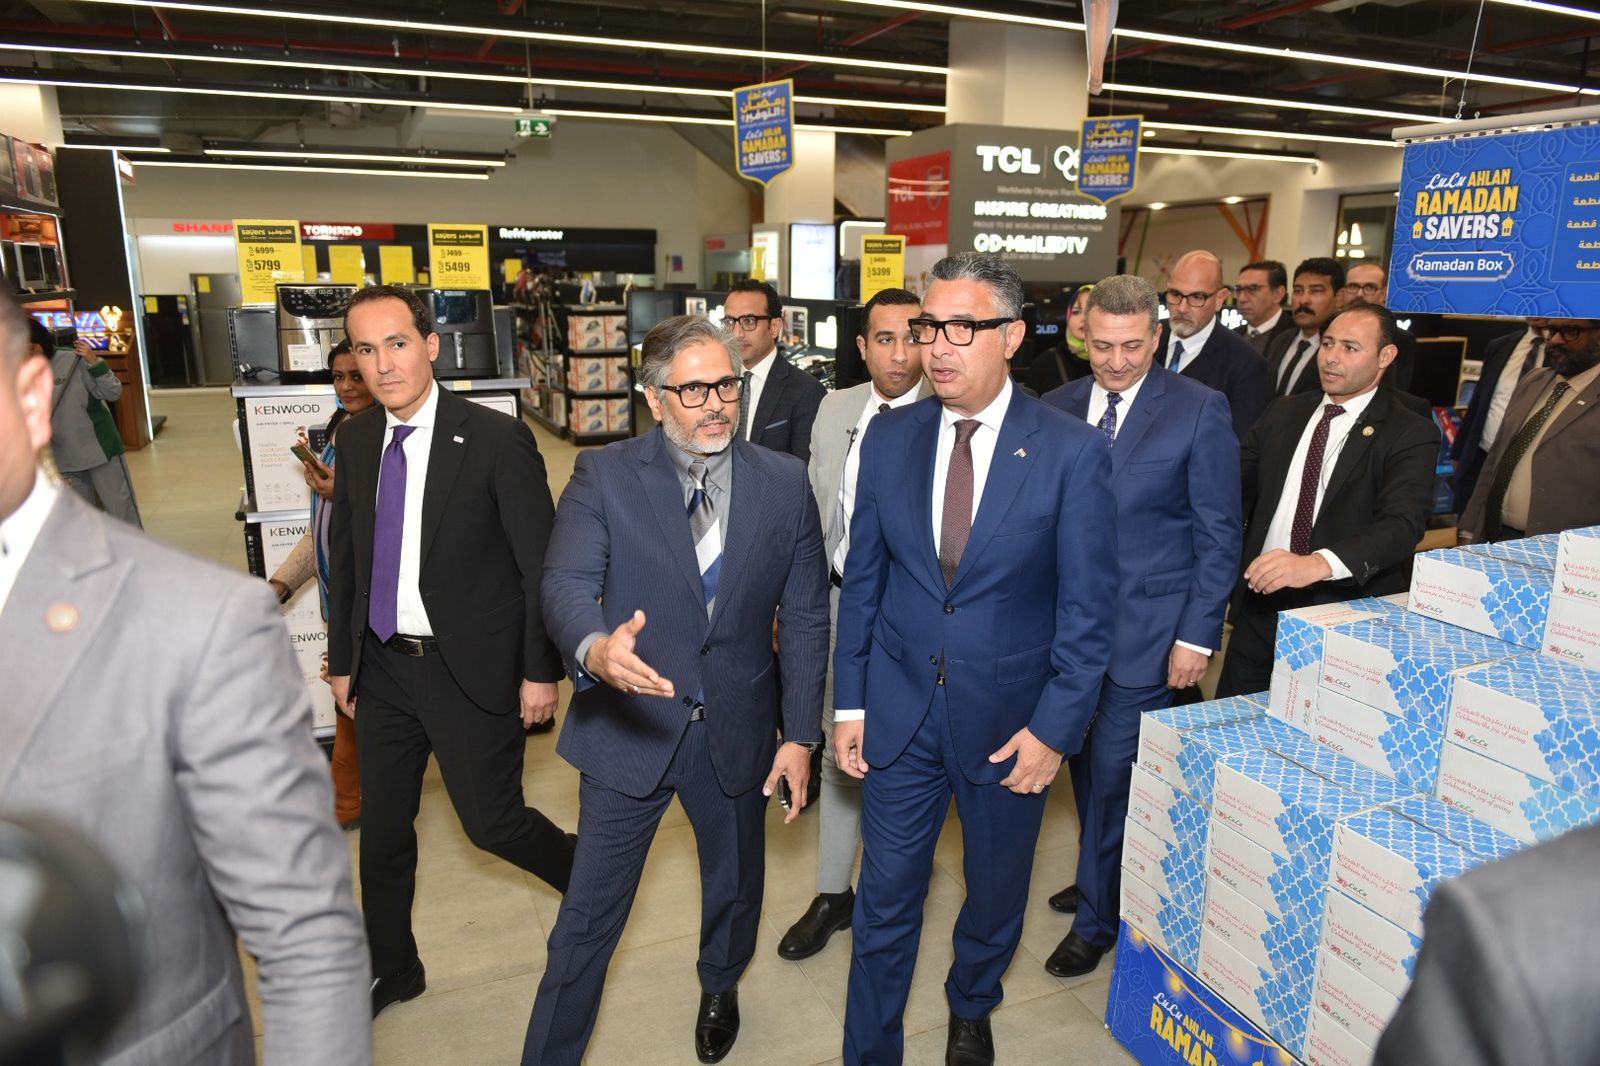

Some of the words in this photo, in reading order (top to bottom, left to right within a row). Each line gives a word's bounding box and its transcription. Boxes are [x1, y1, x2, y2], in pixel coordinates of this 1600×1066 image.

[742, 134, 787, 153] RAMADAN
[748, 150, 781, 166] SAVERS
[976, 145, 1041, 174] TCL
[1083, 162, 1130, 174] RAMADAN
[1088, 174, 1123, 186] SAVERS
[1425, 172, 1468, 190] LuLu
[1467, 168, 1511, 187] AHLAN
[894, 186, 915, 203] TCL
[1061, 188, 1077, 196] Part
[1415, 186, 1519, 216] RAMADAN
[1573, 196, 1600, 206] طعة
[974, 200, 1029, 217] INSPIRE
[1030, 202, 1107, 220] GREATNESS
[173, 222, 233, 233] SHARP
[303, 225, 363, 236] TORNADO
[1424, 214, 1500, 240] SAVERS
[1567, 220, 1597, 229] قطعة
[500, 227, 563, 241] Refrigerator
[254, 260, 281, 271] 5799
[445, 262, 471, 272] 5499
[1416, 259, 1474, 271] Ramadan
[1478, 258, 1503, 271] Box
[872, 267, 891, 276] 5399
[255, 404, 320, 415] KENWOOD
[270, 526, 307, 537] KENW
[1576, 588, 1597, 598] LuLu
[290, 632, 328, 643] ENWO
[1562, 648, 1584, 659] LuLu
[1335, 678, 1351, 688] LuLu
[1455, 711, 1479, 725] Celebrate
[1508, 735, 1526, 744] giving
[1467, 735, 1488, 746] LuLu
[1442, 778, 1466, 793] Celebrate
[1494, 804, 1511, 815] giving
[1453, 801, 1474, 813] LuLu
[1336, 859, 1360, 875] Celebrate
[1348, 882, 1368, 897] LuLu
[1330, 927, 1353, 945] Celebrate
[1379, 958, 1395, 971] giving
[1343, 951, 1362, 967] LuLu
[1153, 993, 1183, 1020] LuLu
[1182, 1014, 1214, 1050] AHLAN
[1332, 1012, 1350, 1027] LuLu
[1150, 1003, 1224, 1066] RAMAD
